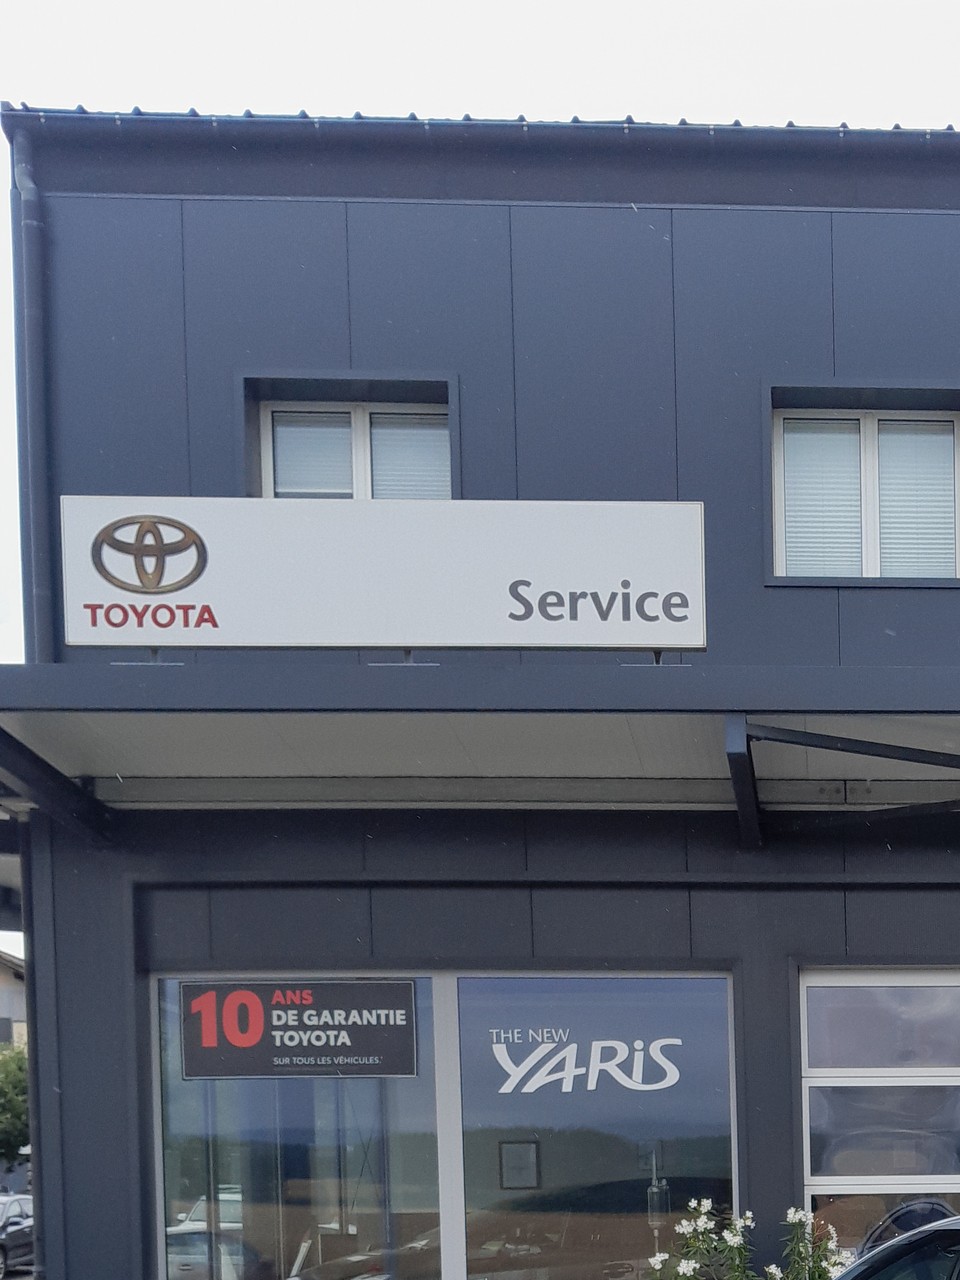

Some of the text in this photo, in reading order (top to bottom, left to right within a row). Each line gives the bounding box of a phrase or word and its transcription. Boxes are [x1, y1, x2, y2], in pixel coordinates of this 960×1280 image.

[507, 579, 689, 623] Service
[83, 603, 219, 629] TOYOTA
[271, 990, 313, 1005] ANS
[191, 989, 264, 1048] 10
[271, 1009, 407, 1026] DE GARANTIE
[271, 1030, 351, 1047] TOYOTA
[489, 1028, 570, 1043] THE NEW
[273, 1057, 291, 1065] SUR
[293, 1056, 316, 1065] TOUS
[317, 1056, 332, 1065] LES
